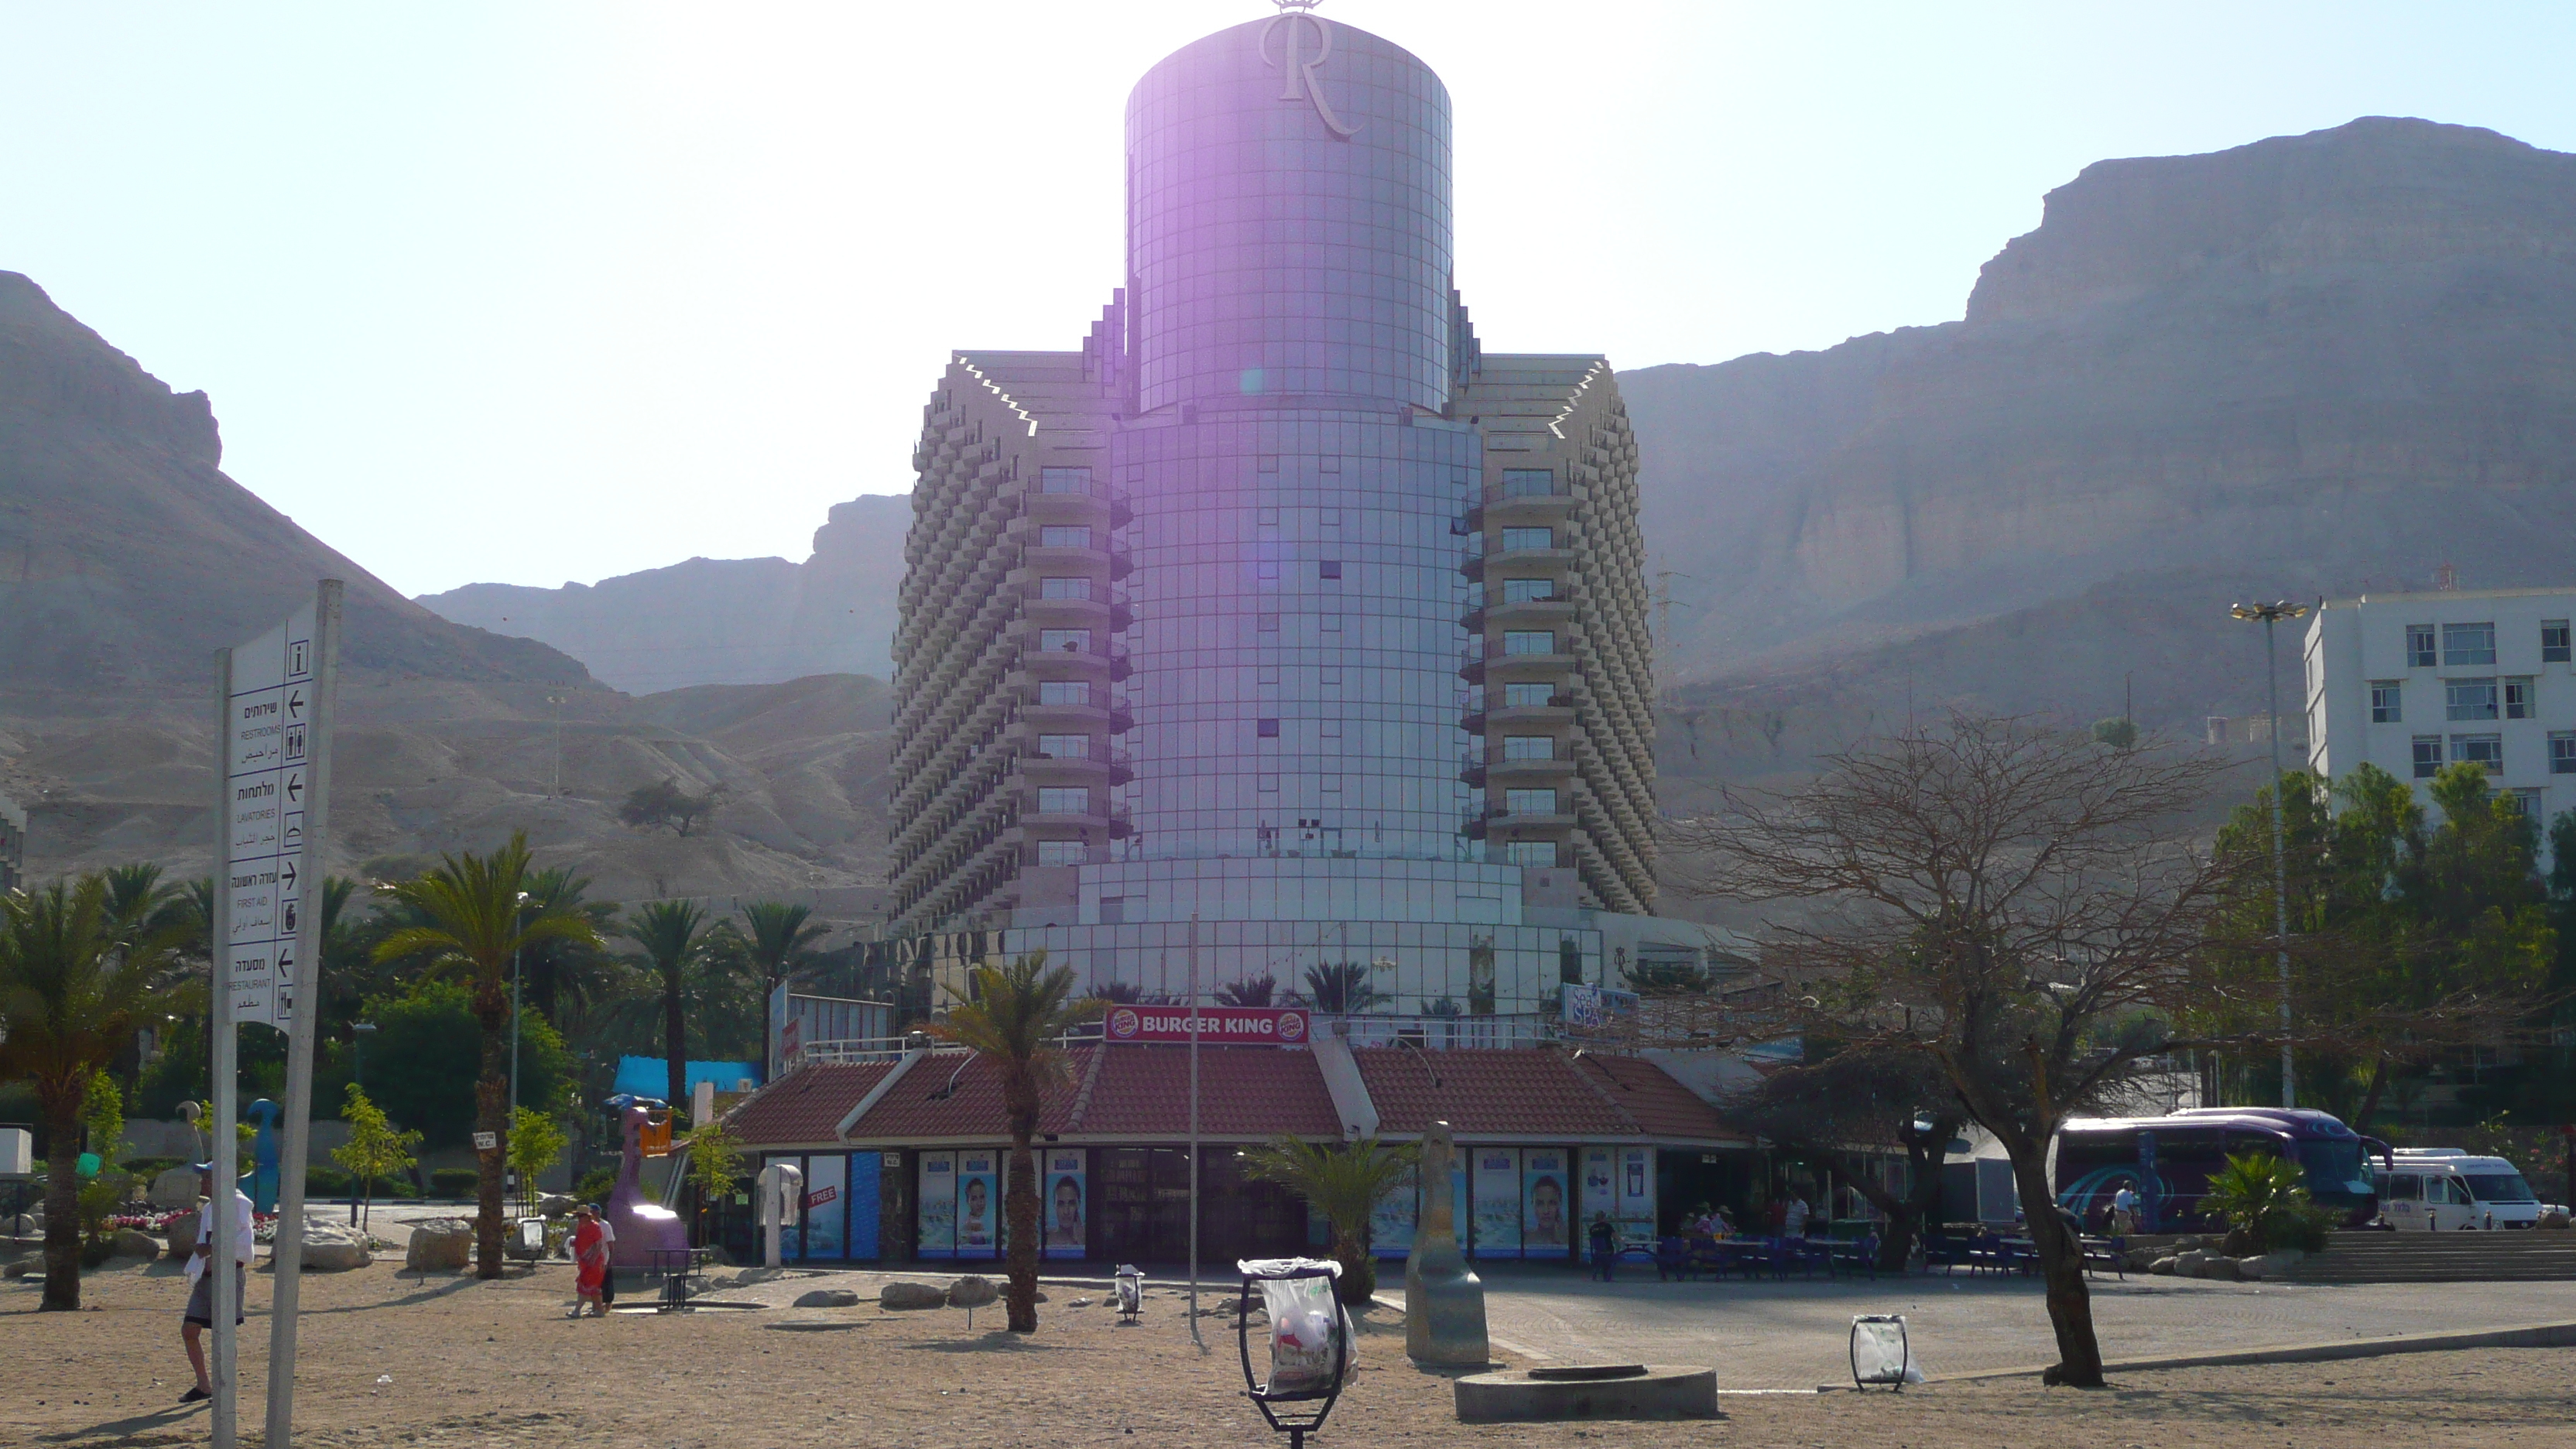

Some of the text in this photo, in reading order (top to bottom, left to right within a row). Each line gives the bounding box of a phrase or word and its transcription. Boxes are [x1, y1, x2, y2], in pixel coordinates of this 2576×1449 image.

[1259, 12, 1365, 135] R
[244, 701, 277, 719] שירותים
[241, 724, 281, 741] RESTROOMS
[237, 781, 274, 800] מלתחות
[237, 808, 276, 824] LAVATORIES
[231, 872, 277, 889] עזרה ראשונה
[237, 896, 268, 909] FIRST AID
[235, 957, 265, 972] מסעדה
[228, 978, 271, 992] RESTAURANT
[1115, 1019, 1136, 1030] KING
[1142, 1016, 1273, 1034] BURGER KING
[810, 1188, 835, 1205] FREE
